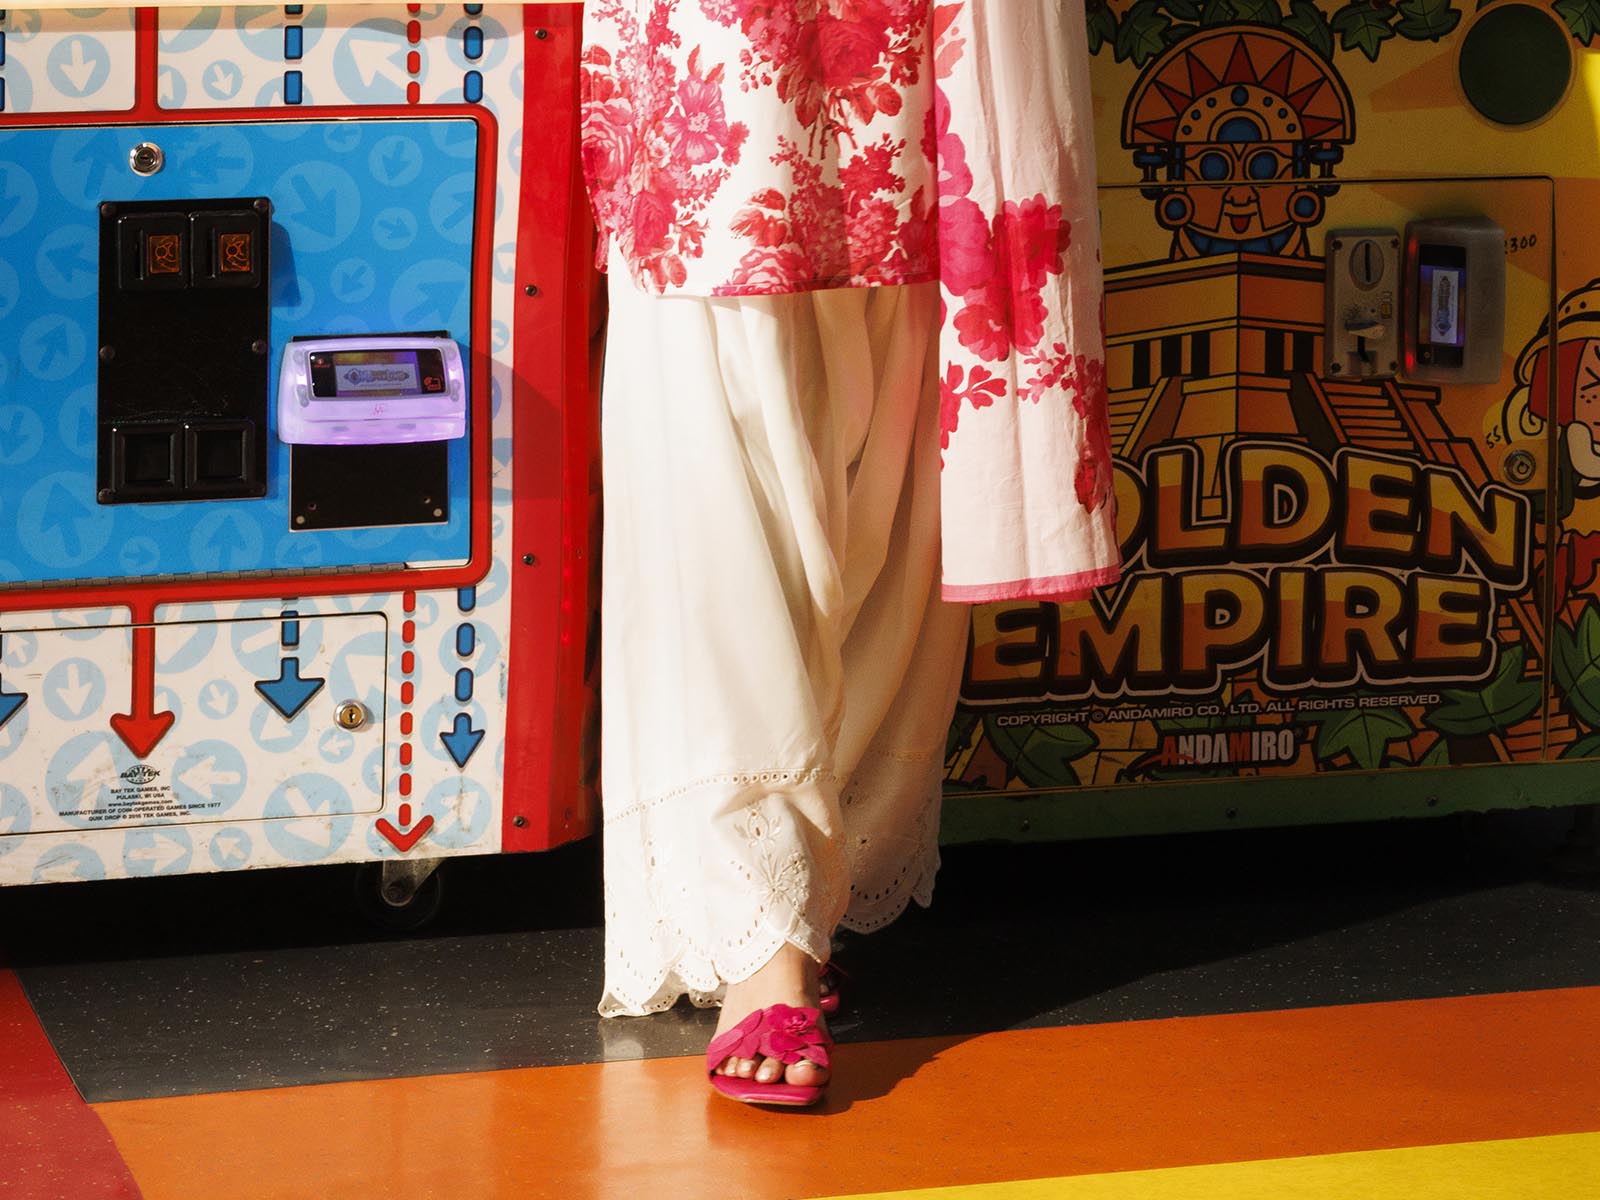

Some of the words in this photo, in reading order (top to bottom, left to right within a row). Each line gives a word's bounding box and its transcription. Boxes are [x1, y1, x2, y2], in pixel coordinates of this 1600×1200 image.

[1113, 445, 1525, 570] LDEN
[968, 565, 1488, 686] EMPIRE
[997, 711, 1089, 727] COPYRIGHT
[1107, 706, 1193, 721] ANDAMIRO
[1197, 704, 1226, 717] CO.,
[1230, 702, 1262, 715] LTD.
[1267, 701, 1295, 713] ALL
[1300, 698, 1355, 711] RIGHTS
[1359, 694, 1442, 708] RESERVED.
[1160, 729, 1294, 767] ANDAMIRO
